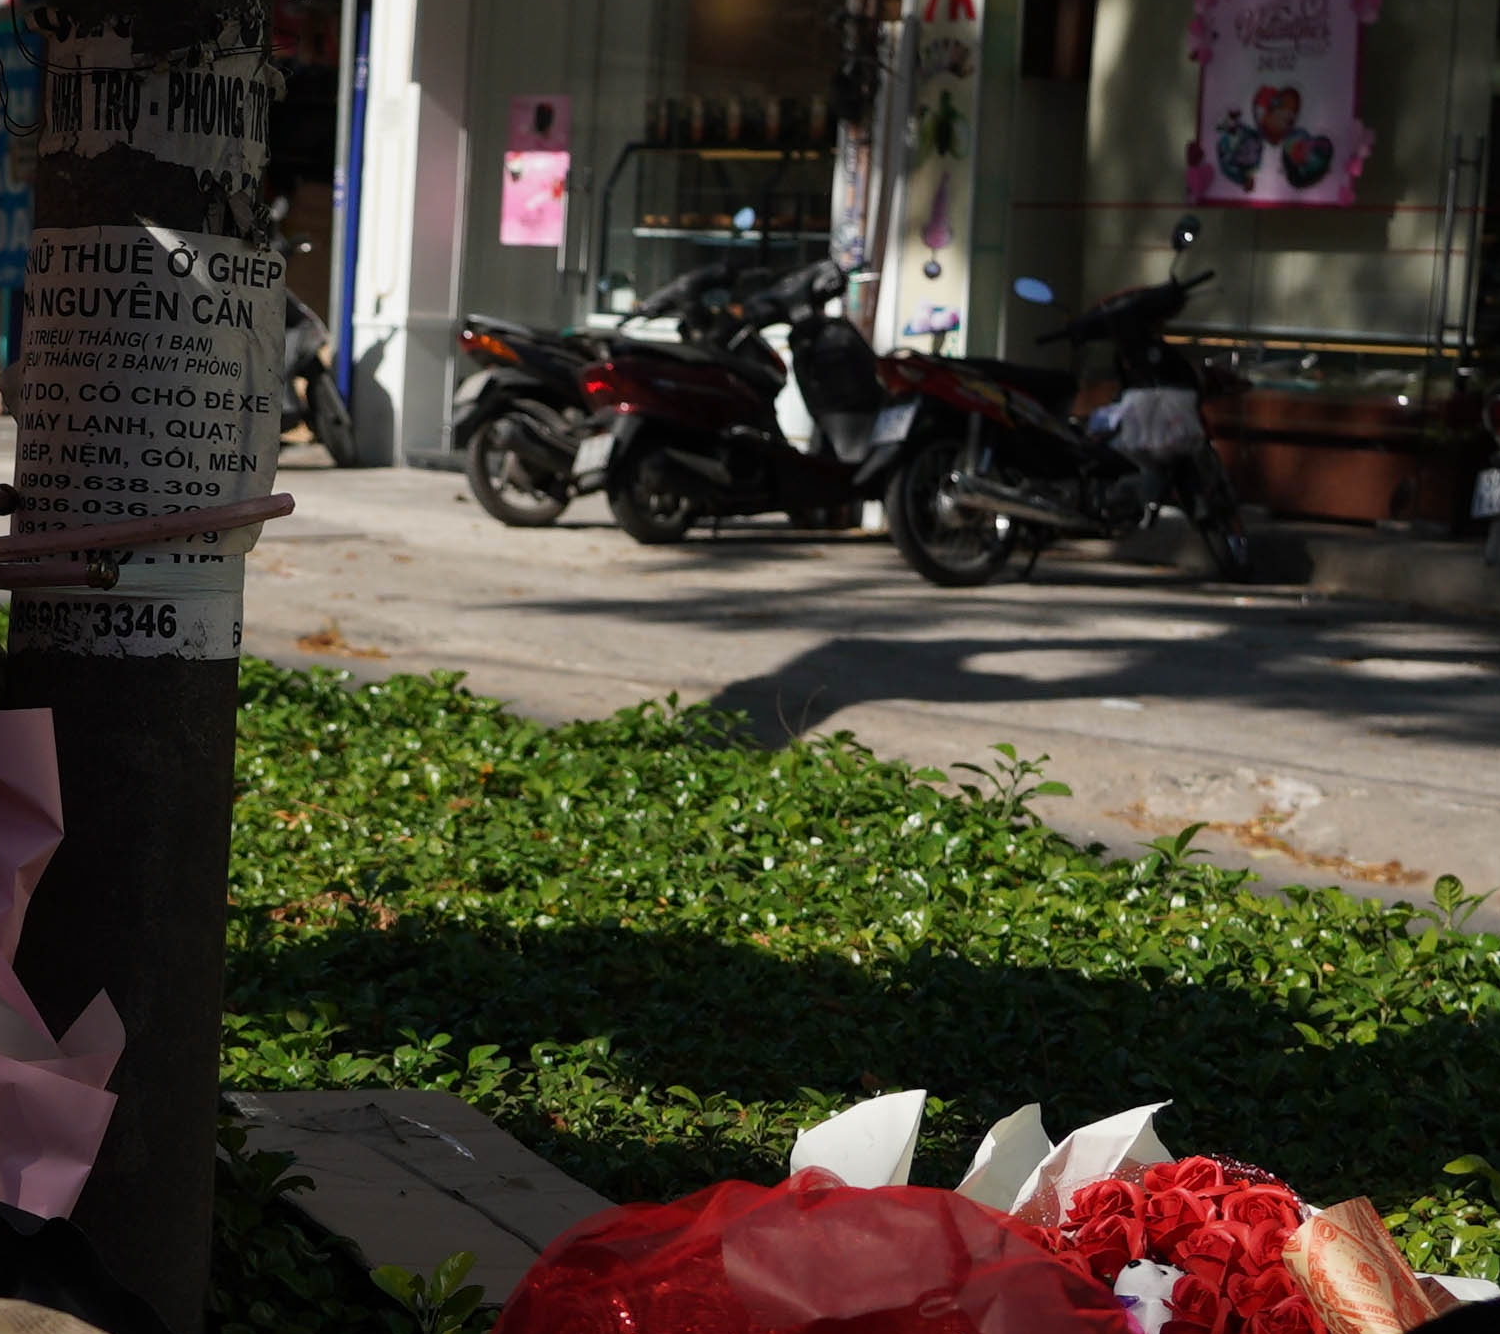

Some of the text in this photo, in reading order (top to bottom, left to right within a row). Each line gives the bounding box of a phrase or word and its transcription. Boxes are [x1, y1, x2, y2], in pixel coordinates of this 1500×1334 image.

[61, 237, 154, 275] THUÊ
[167, 240, 198, 278] Ở
[208, 252, 283, 289] GHÉP
[40, 281, 179, 322] NGUYÊN
[192, 289, 254, 329] CĂN
[155, 333, 164, 349] 1
[170, 334, 213, 356] BẠN)
[107, 353, 117, 368] 2
[79, 380, 121, 403] CÓ
[239, 394, 270, 413] XE
[25, 409, 61, 431] MÁY
[68, 414, 154, 440] LẠNH,
[20, 472, 221, 498] 0909.638.309
